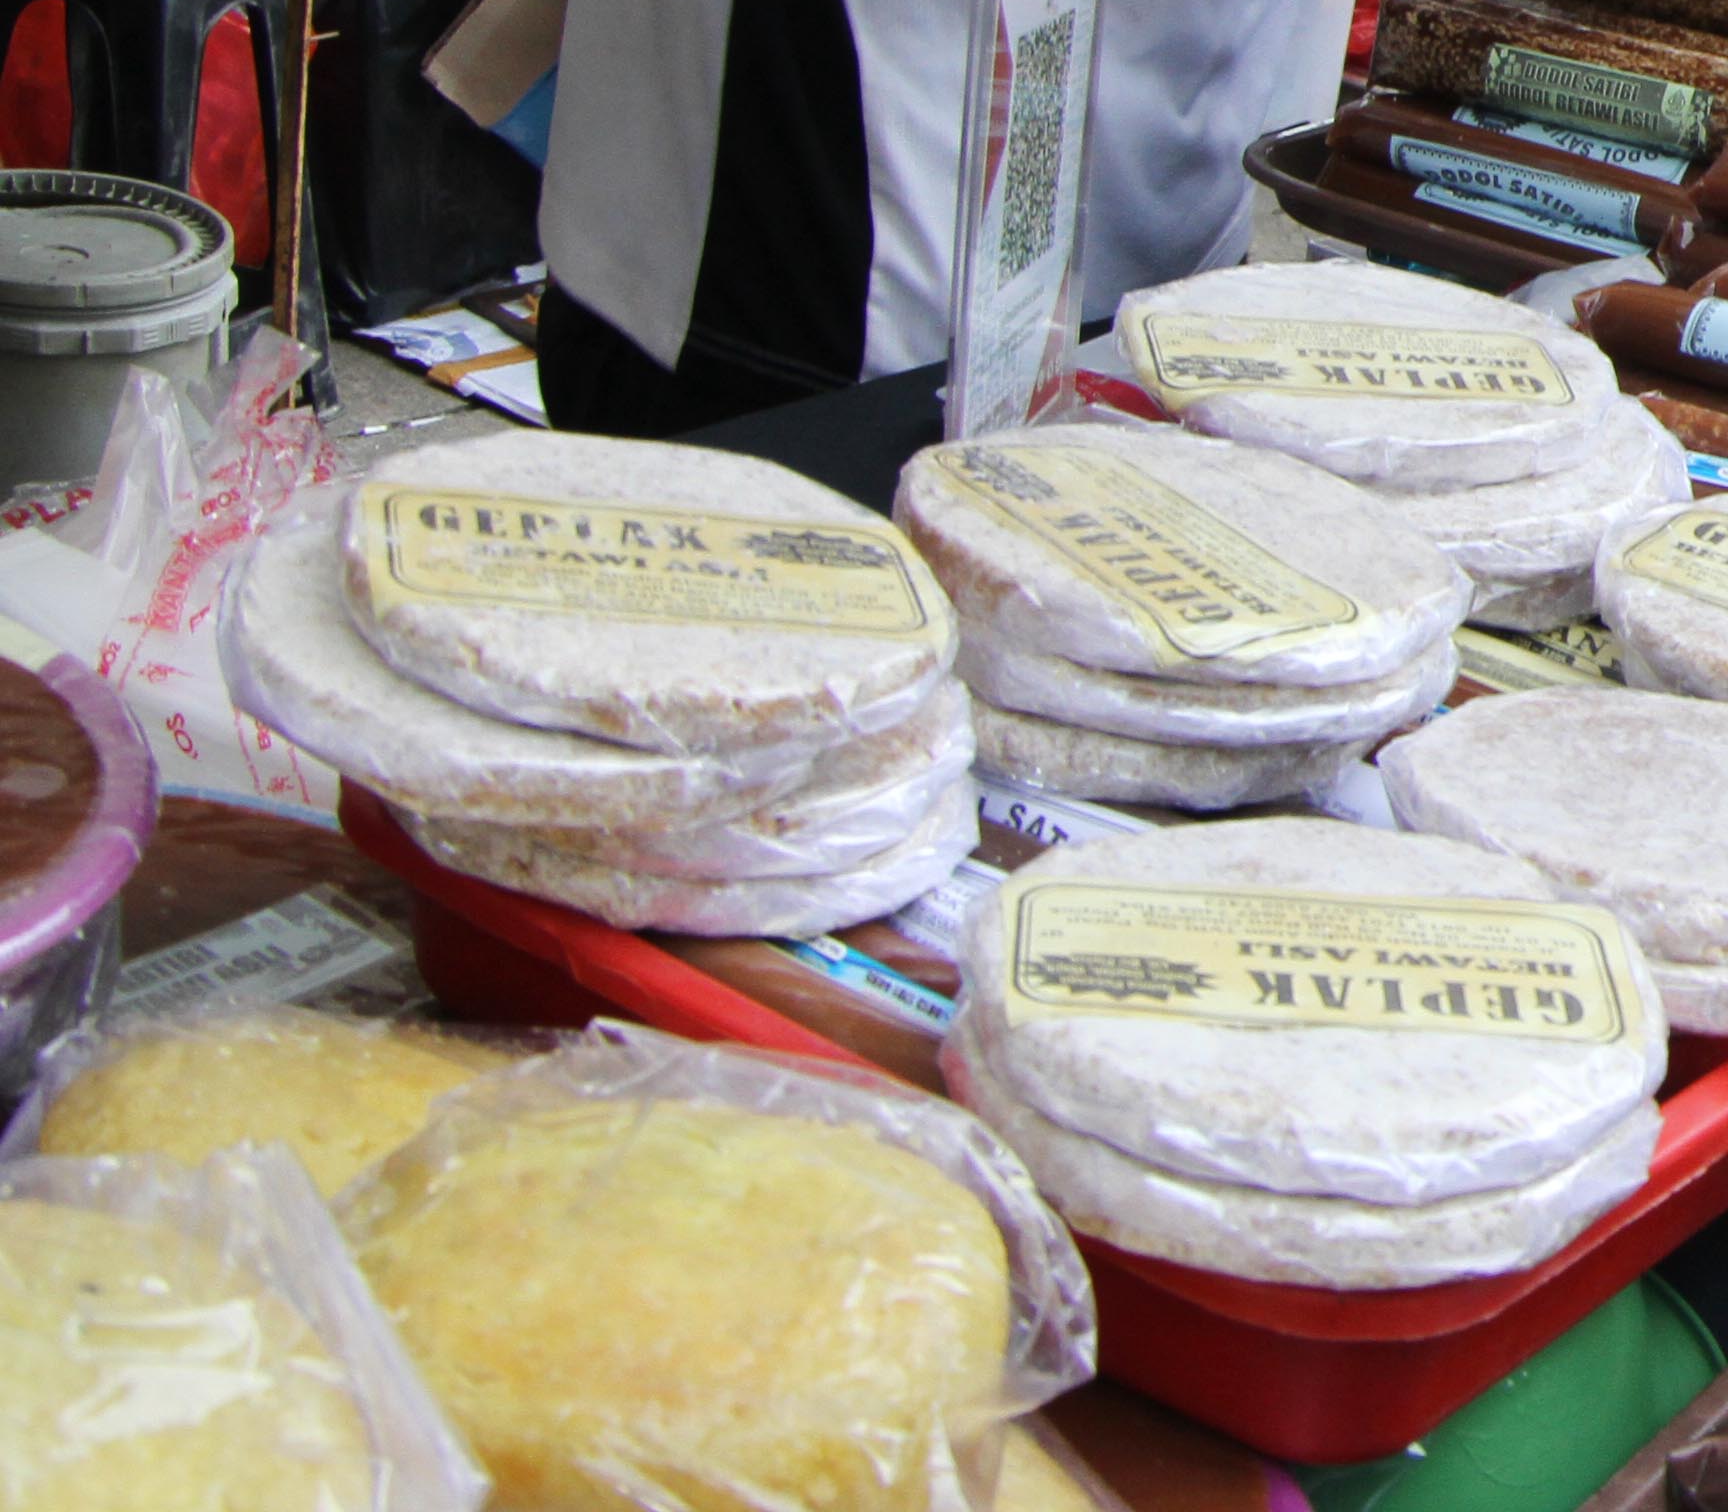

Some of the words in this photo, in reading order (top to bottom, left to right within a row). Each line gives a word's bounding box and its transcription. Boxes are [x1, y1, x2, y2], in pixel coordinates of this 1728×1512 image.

[1521, 60, 1581, 90] DODOL
[1582, 73, 1641, 103] SATIBI
[1295, 348, 1378, 362] ASLI
[1391, 351, 1528, 370] BETAWI
[1314, 365, 1547, 395] GEPLAK
[1056, 514, 1234, 625] GEPLAK
[1237, 940, 1360, 965] ASLI
[1375, 947, 1574, 979] BETAWI
[1246, 968, 1585, 1028] GEPLAK
